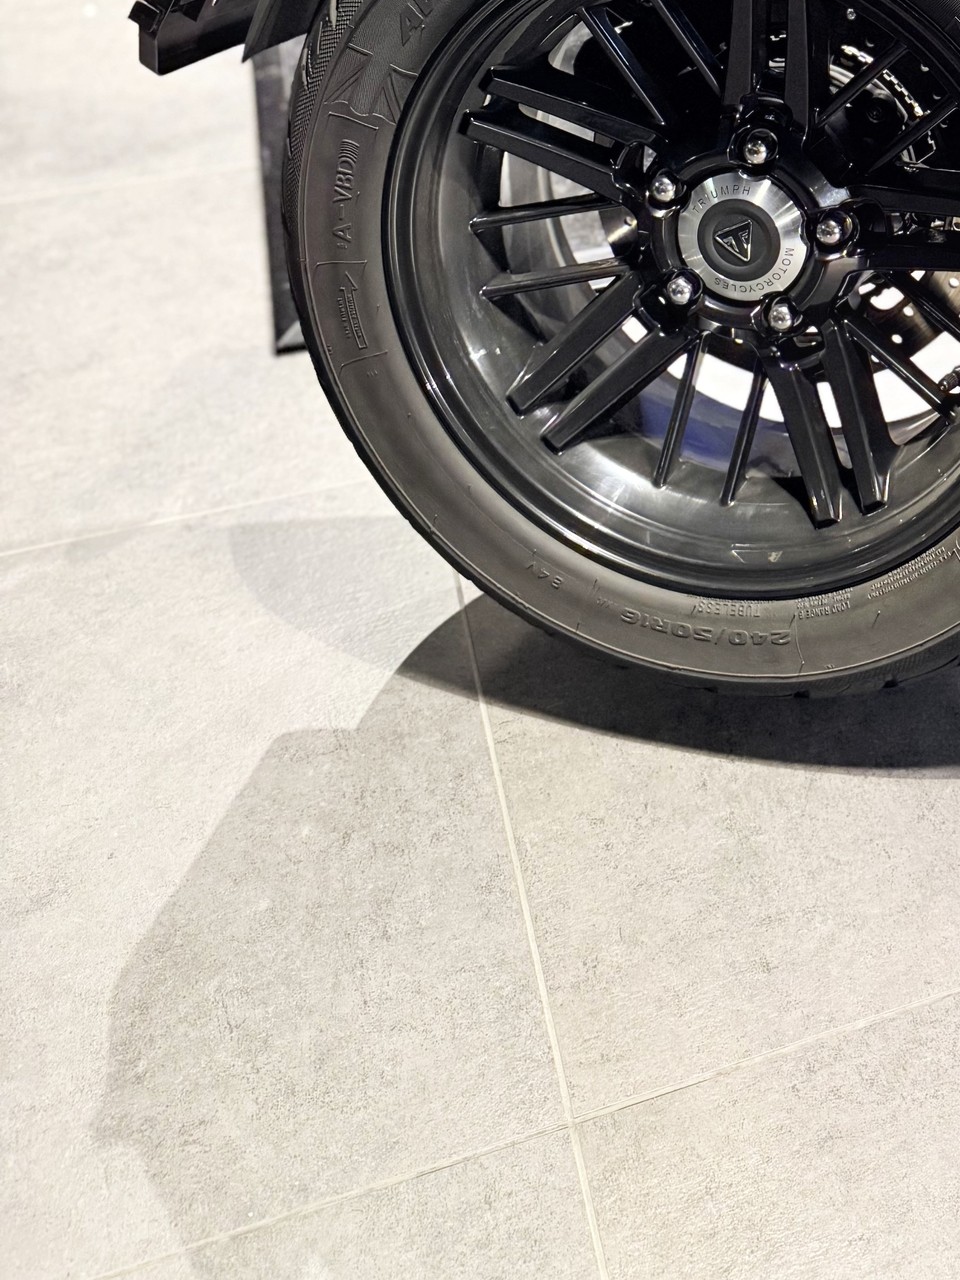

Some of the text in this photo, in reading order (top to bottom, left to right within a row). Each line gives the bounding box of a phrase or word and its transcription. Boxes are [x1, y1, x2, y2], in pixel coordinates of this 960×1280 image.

[691, 184, 750, 214] TRIUMPH
[713, 247, 795, 293] MOTORCYCLES
[620, 606, 792, 646] 240/50R16
[697, 599, 761, 618] TUBELESS
